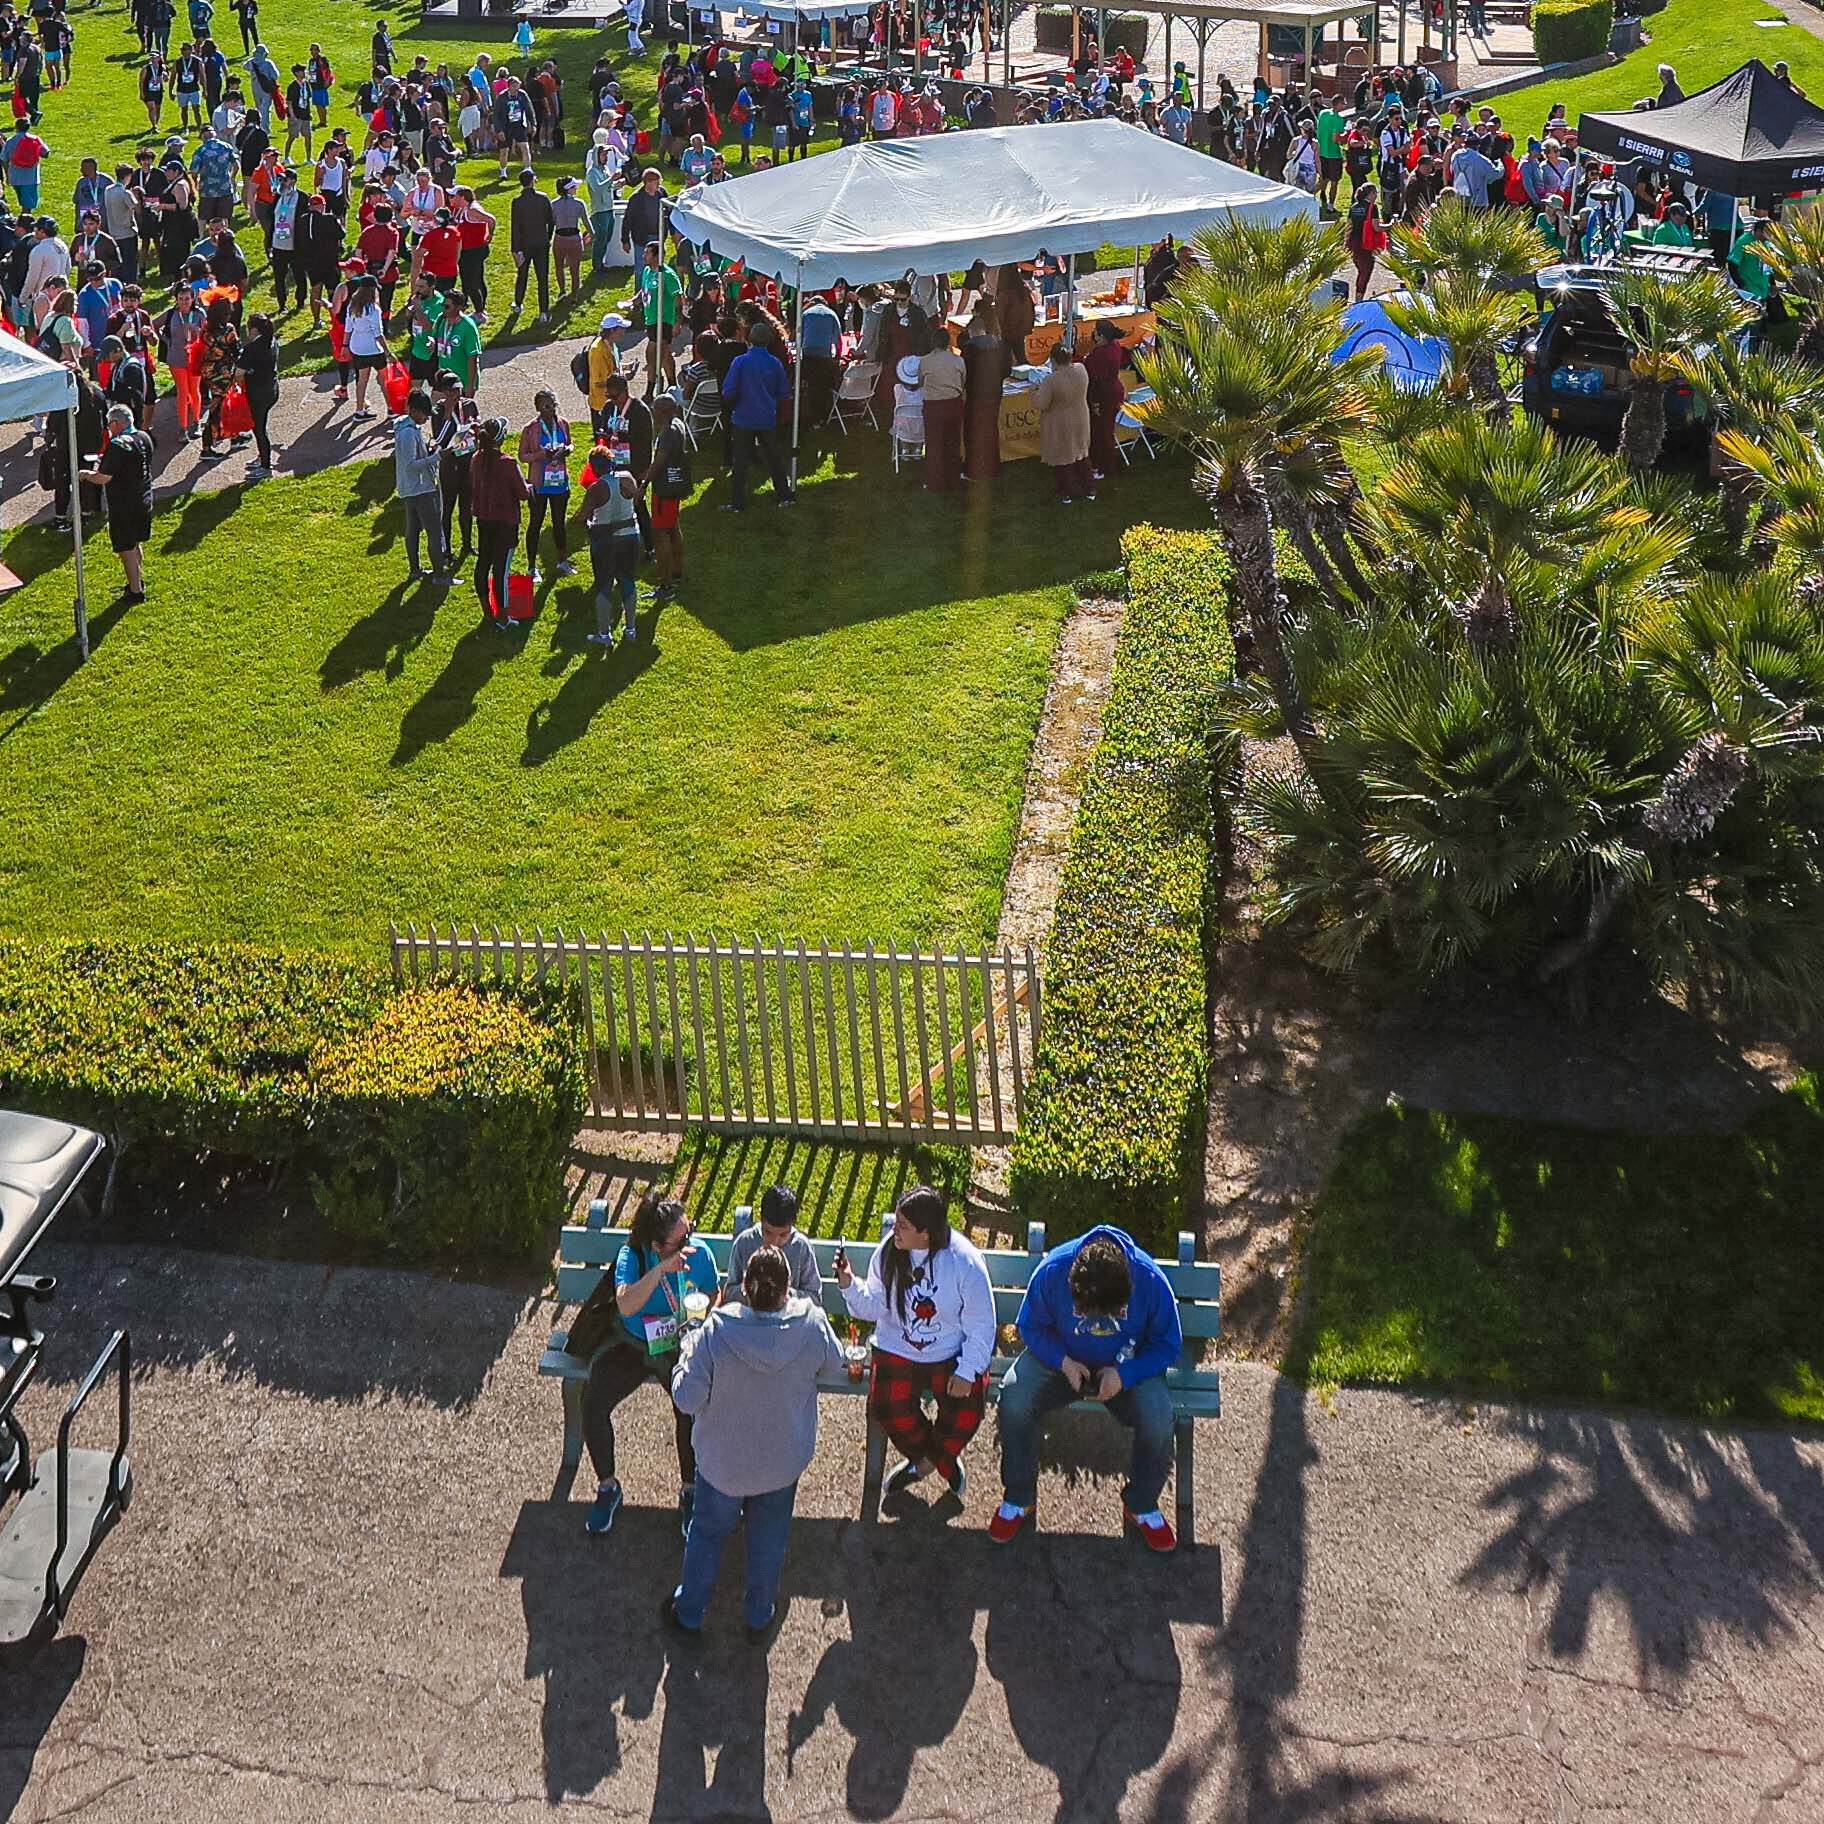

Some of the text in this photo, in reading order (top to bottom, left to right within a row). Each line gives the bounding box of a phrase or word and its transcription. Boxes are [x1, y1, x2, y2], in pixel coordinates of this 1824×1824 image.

[1625, 137, 1664, 160] SIERRA
[1669, 163, 1693, 177] SUBARU
[1029, 336, 1054, 351] USC
[1005, 409, 1037, 429] USC
